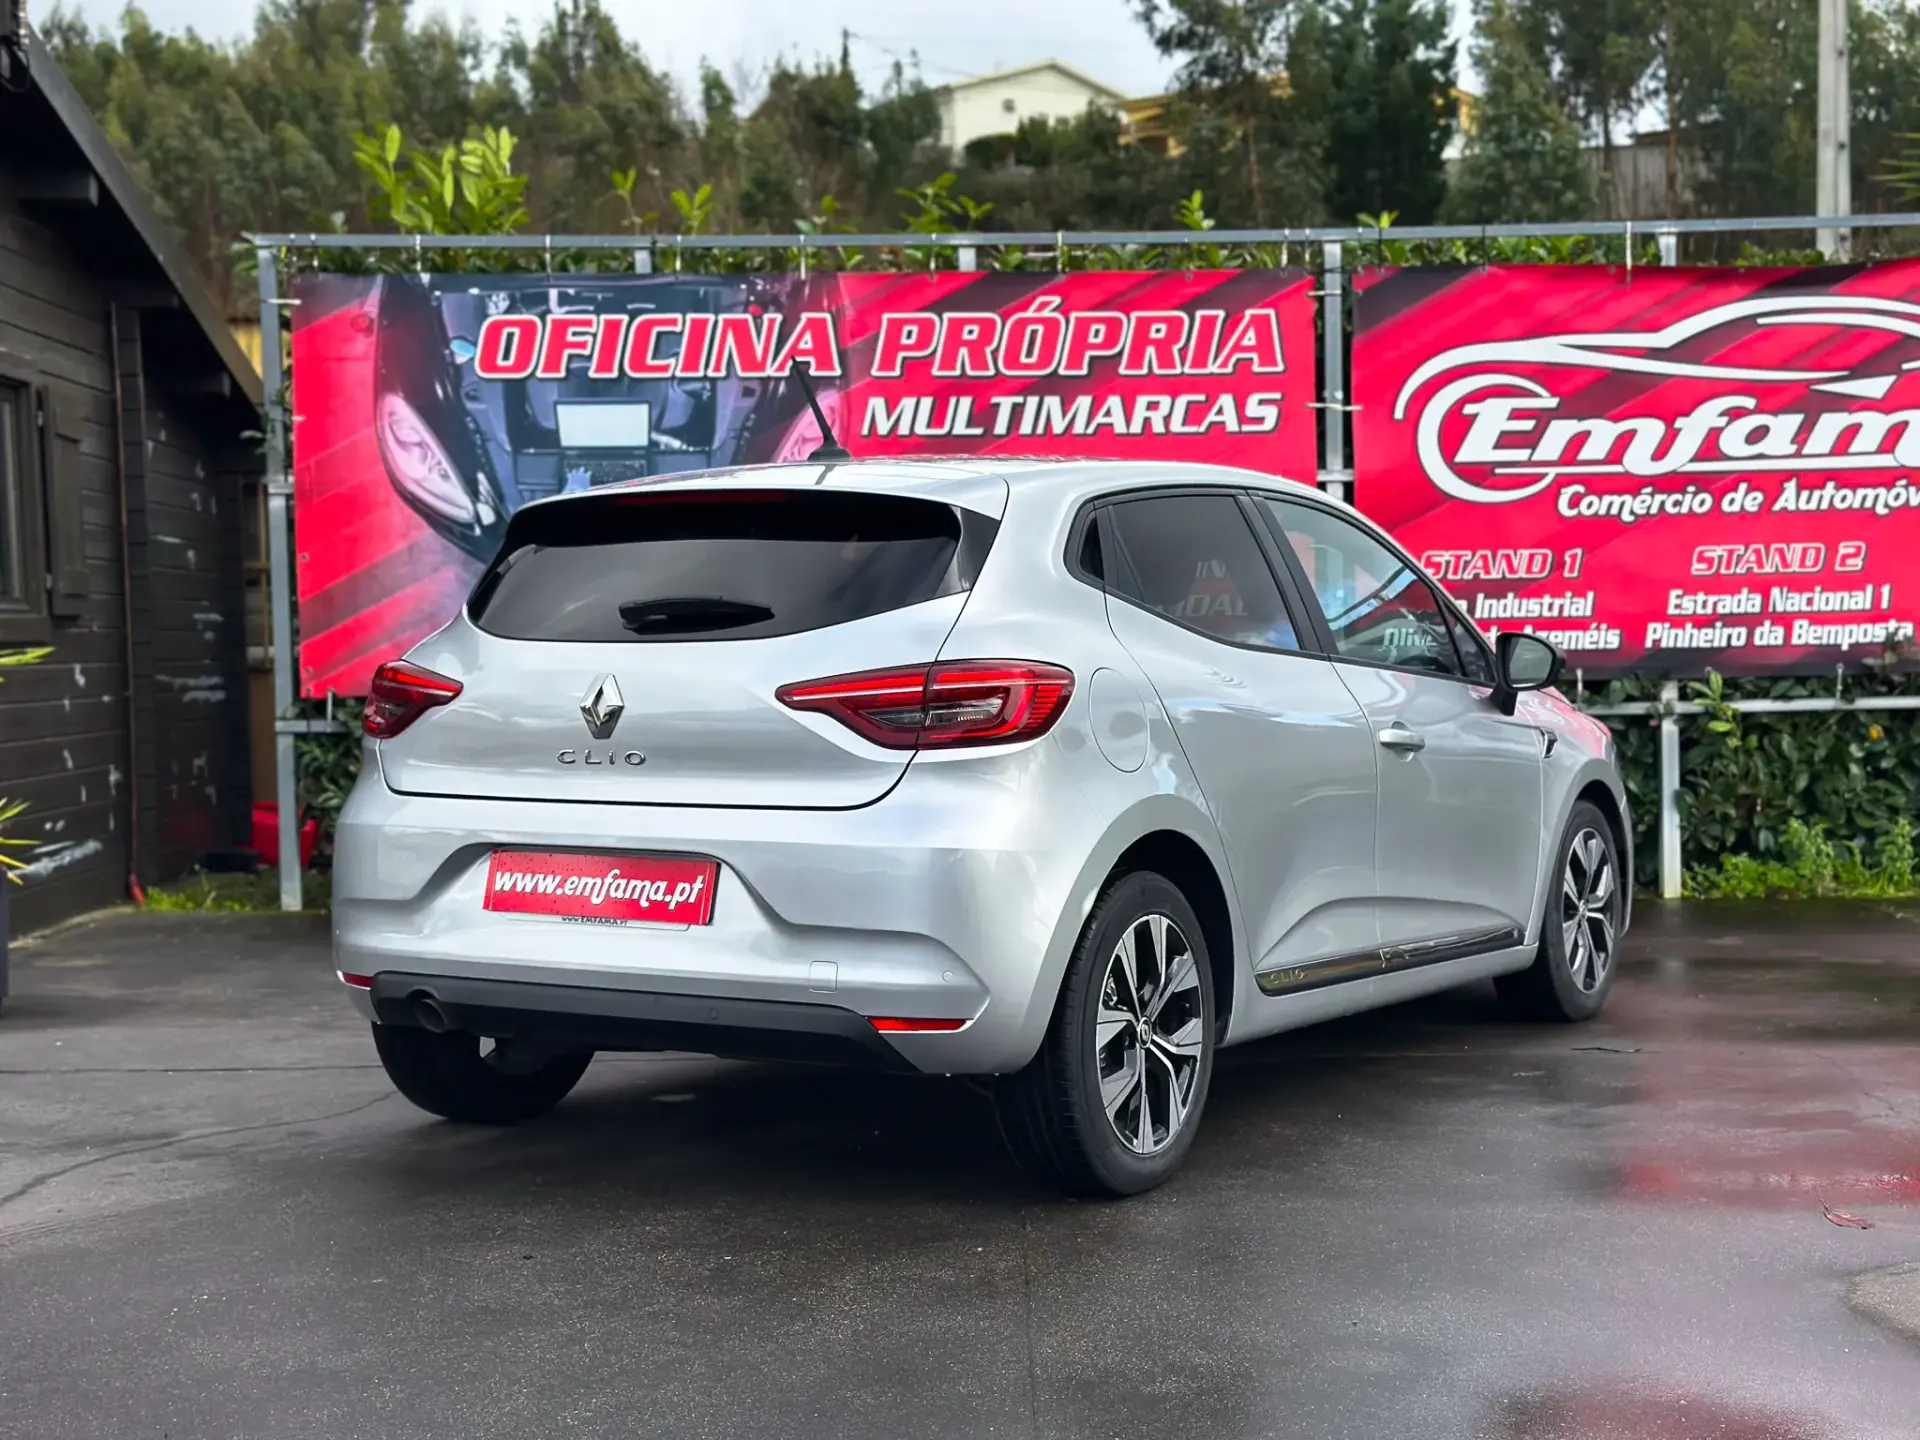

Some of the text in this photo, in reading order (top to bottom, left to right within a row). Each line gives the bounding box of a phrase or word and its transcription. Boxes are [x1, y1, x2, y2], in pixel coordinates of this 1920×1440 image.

[474, 295, 1285, 379] OFICINA PRÓPRIA
[861, 391, 1283, 436] MULTIMARCAS
[1557, 484, 1712, 523] Comércio
[1720, 482, 1764, 514] de
[1421, 547, 1584, 580] STAND 1
[1690, 541, 1866, 575] STAND 2
[1474, 591, 1595, 619] Industrial
[1667, 583, 1892, 616] Estrada Nacional 1
[1644, 618, 1914, 652] Pinheiro da Bemposta
[556, 748, 647, 767] CLIO
[494, 868, 704, 910] www.emfama.pt
